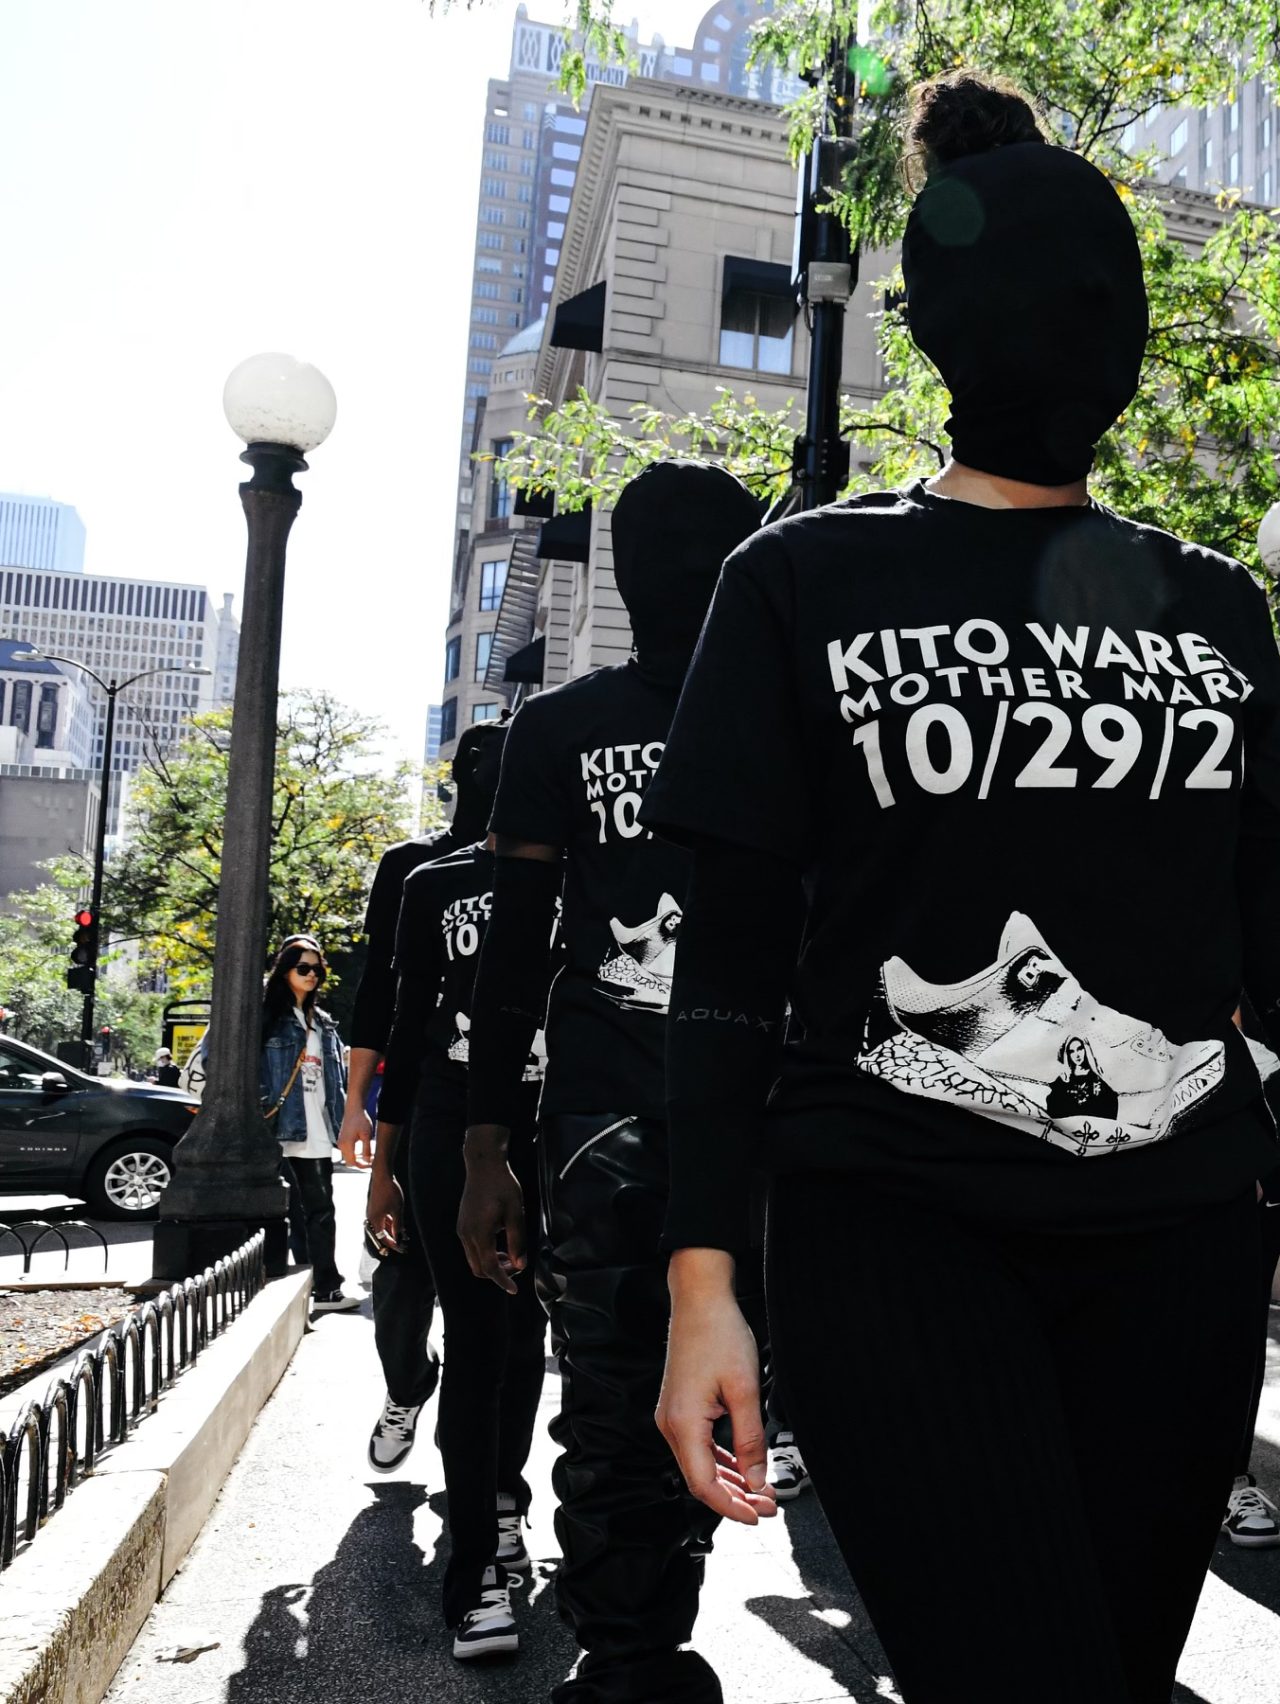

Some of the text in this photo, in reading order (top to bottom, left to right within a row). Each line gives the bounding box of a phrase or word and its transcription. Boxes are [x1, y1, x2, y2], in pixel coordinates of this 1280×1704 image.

[827, 618, 1010, 693] KITO
[840, 666, 1091, 723] MOTHER
[853, 700, 1245, 809] 10/29/2
[586, 769, 656, 801] MOT
[445, 923, 479, 961] 10
